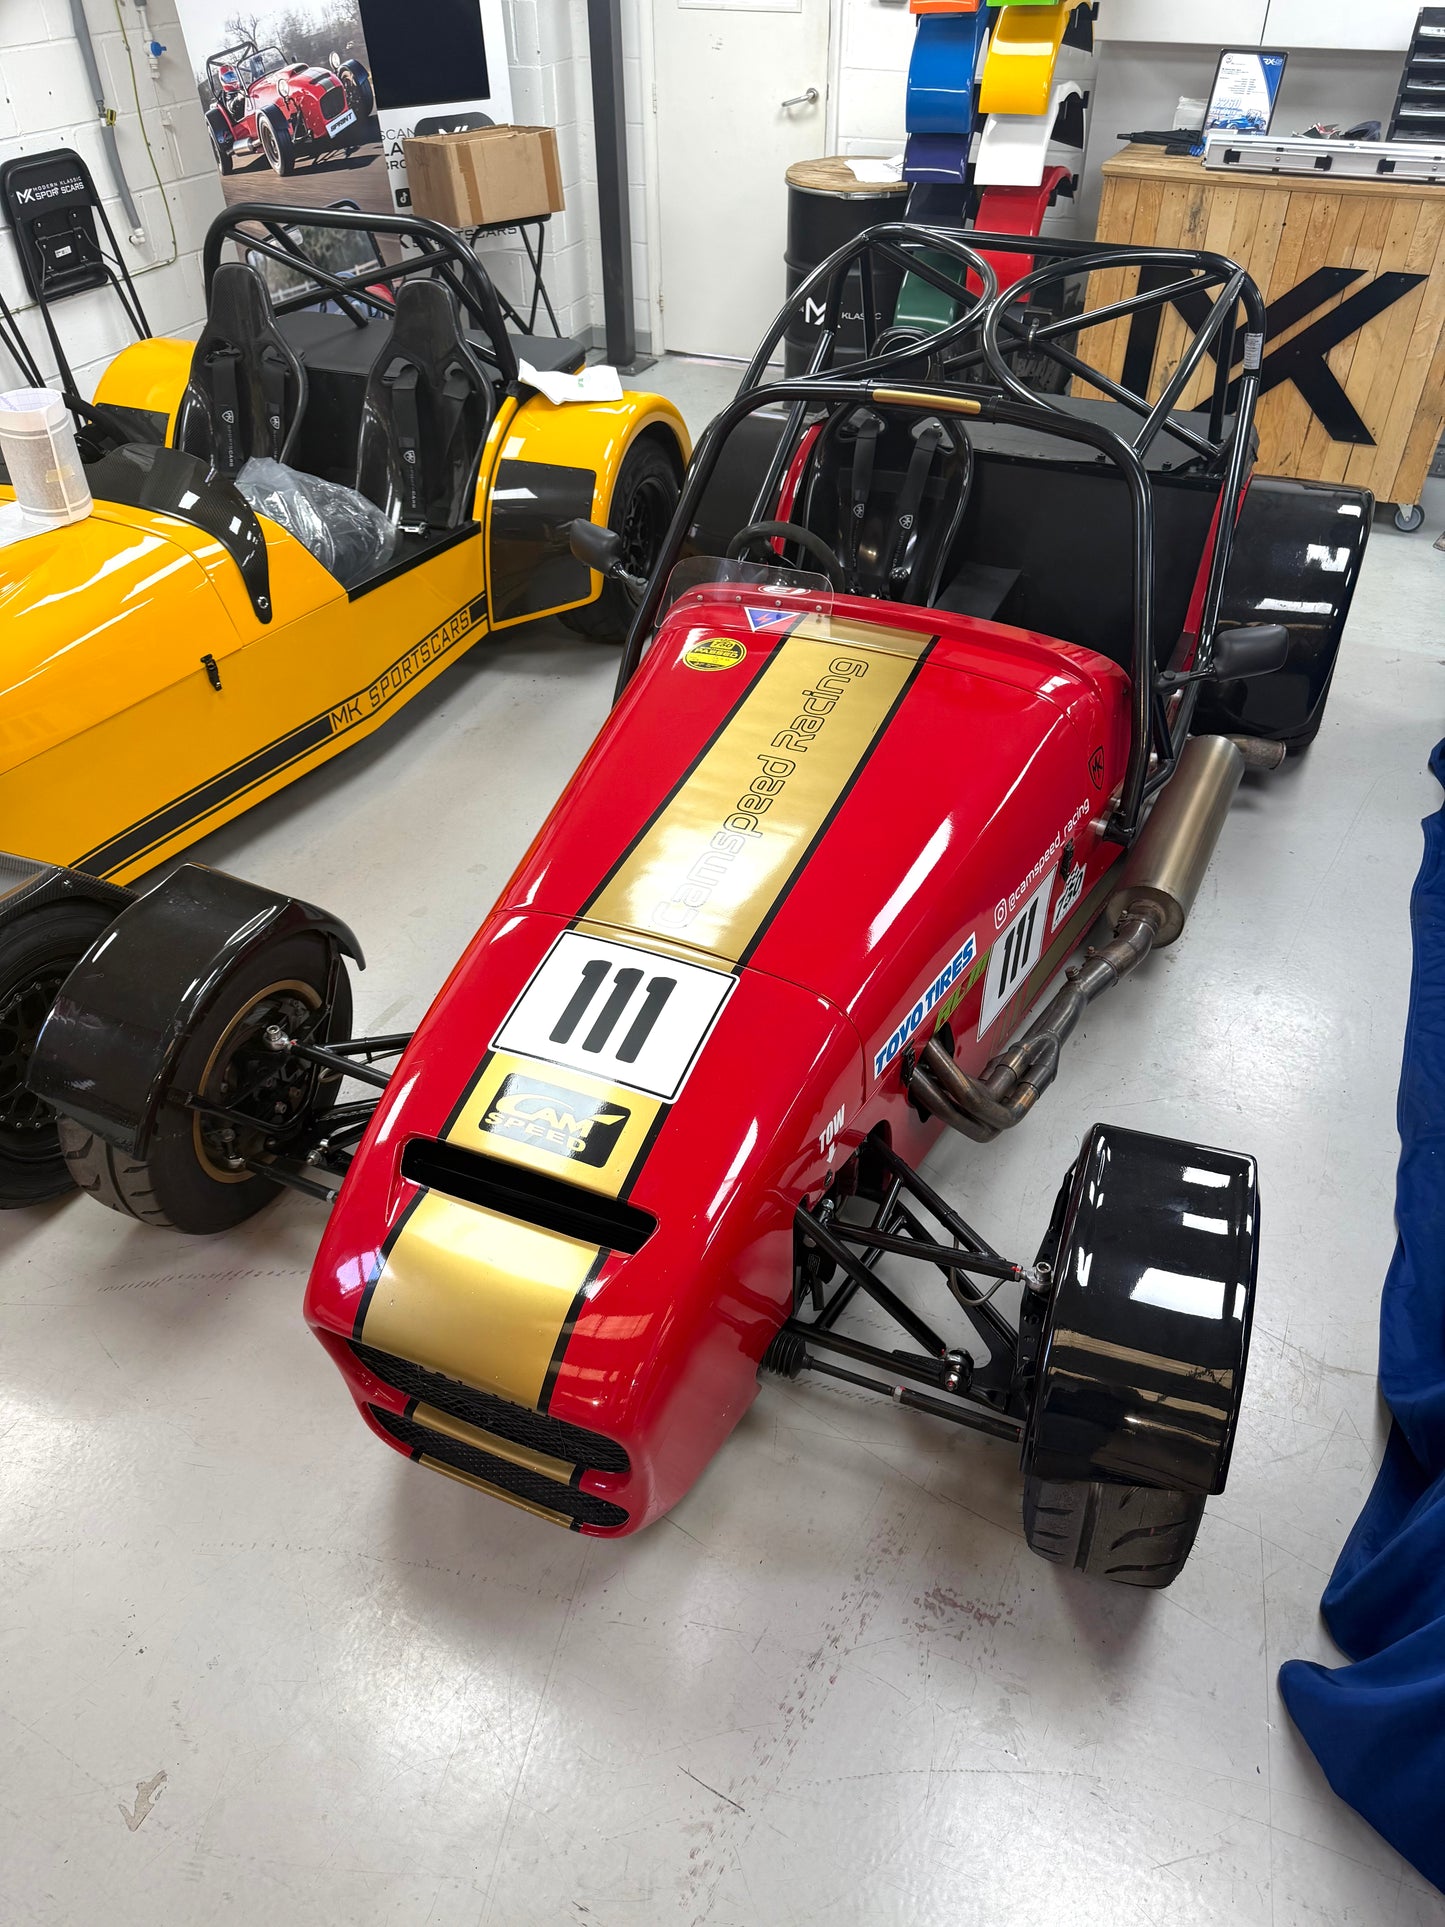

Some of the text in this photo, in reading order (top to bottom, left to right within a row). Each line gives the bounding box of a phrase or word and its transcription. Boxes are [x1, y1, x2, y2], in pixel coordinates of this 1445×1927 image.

[331, 609, 470, 730] MK SPORTSCARS
[651, 754, 797, 930] Camspeed
[770, 656, 870, 753] Racing
[1008, 798, 1090, 913] @camspeed_racing
[998, 896, 1039, 1000] 111
[548, 959, 678, 1064] 111
[875, 1001, 924, 1076] TOYO
[925, 937, 975, 1013] TIRES
[484, 1111, 587, 1153] SPEED
[495, 1093, 602, 1139] CAM
[818, 1103, 846, 1155] TOW
